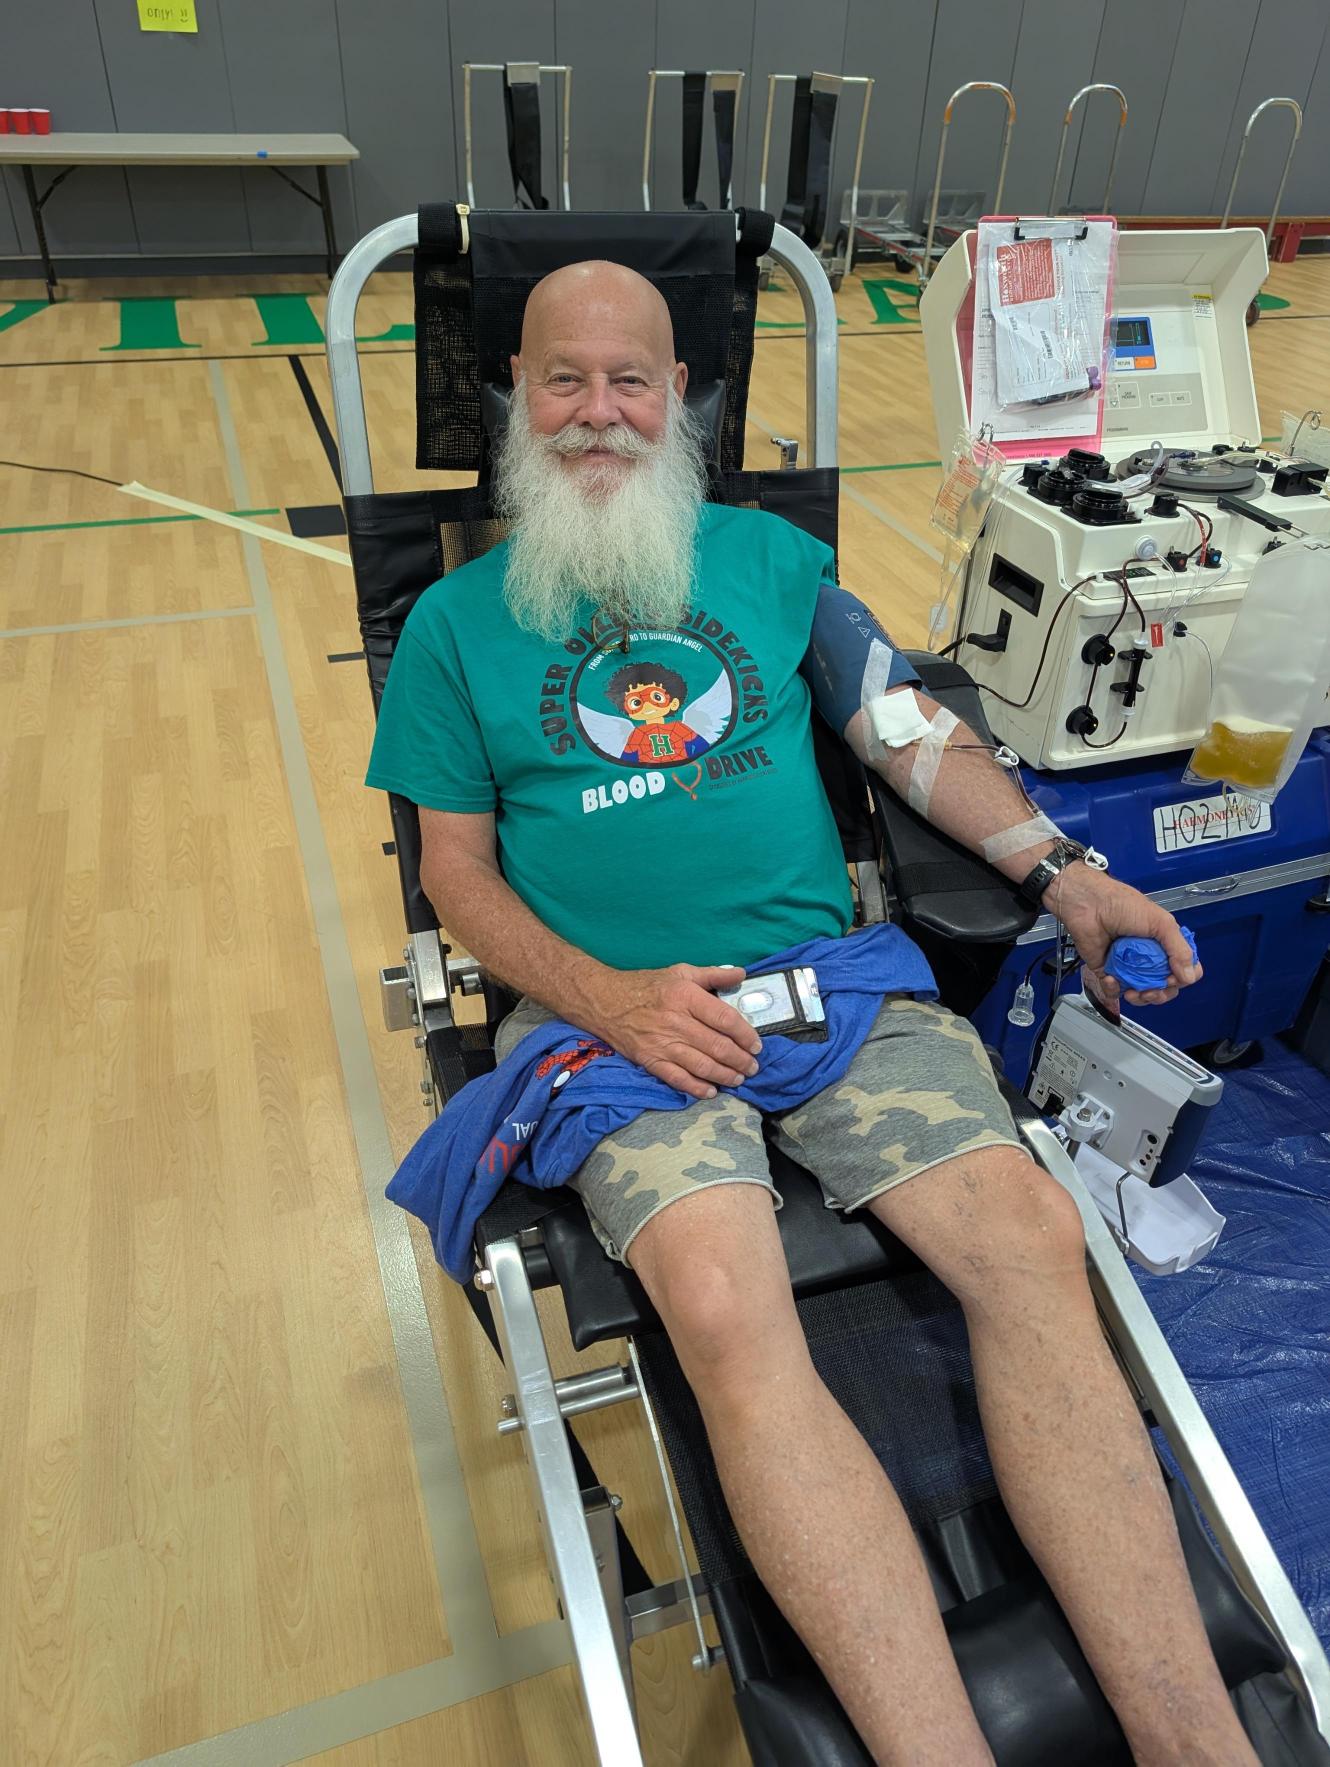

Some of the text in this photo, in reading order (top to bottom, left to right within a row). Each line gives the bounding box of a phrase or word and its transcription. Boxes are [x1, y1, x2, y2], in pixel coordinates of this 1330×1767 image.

[640, 632, 648, 641] TO
[649, 632, 681, 644] GUARDIAN
[682, 638, 703, 653] ANGEL
[588, 652, 604, 671] FROM
[540, 664, 576, 756] SUPER
[648, 733, 675, 757] H
[582, 771, 665, 814] BLOOD
[704, 746, 773, 779] DRIVE
